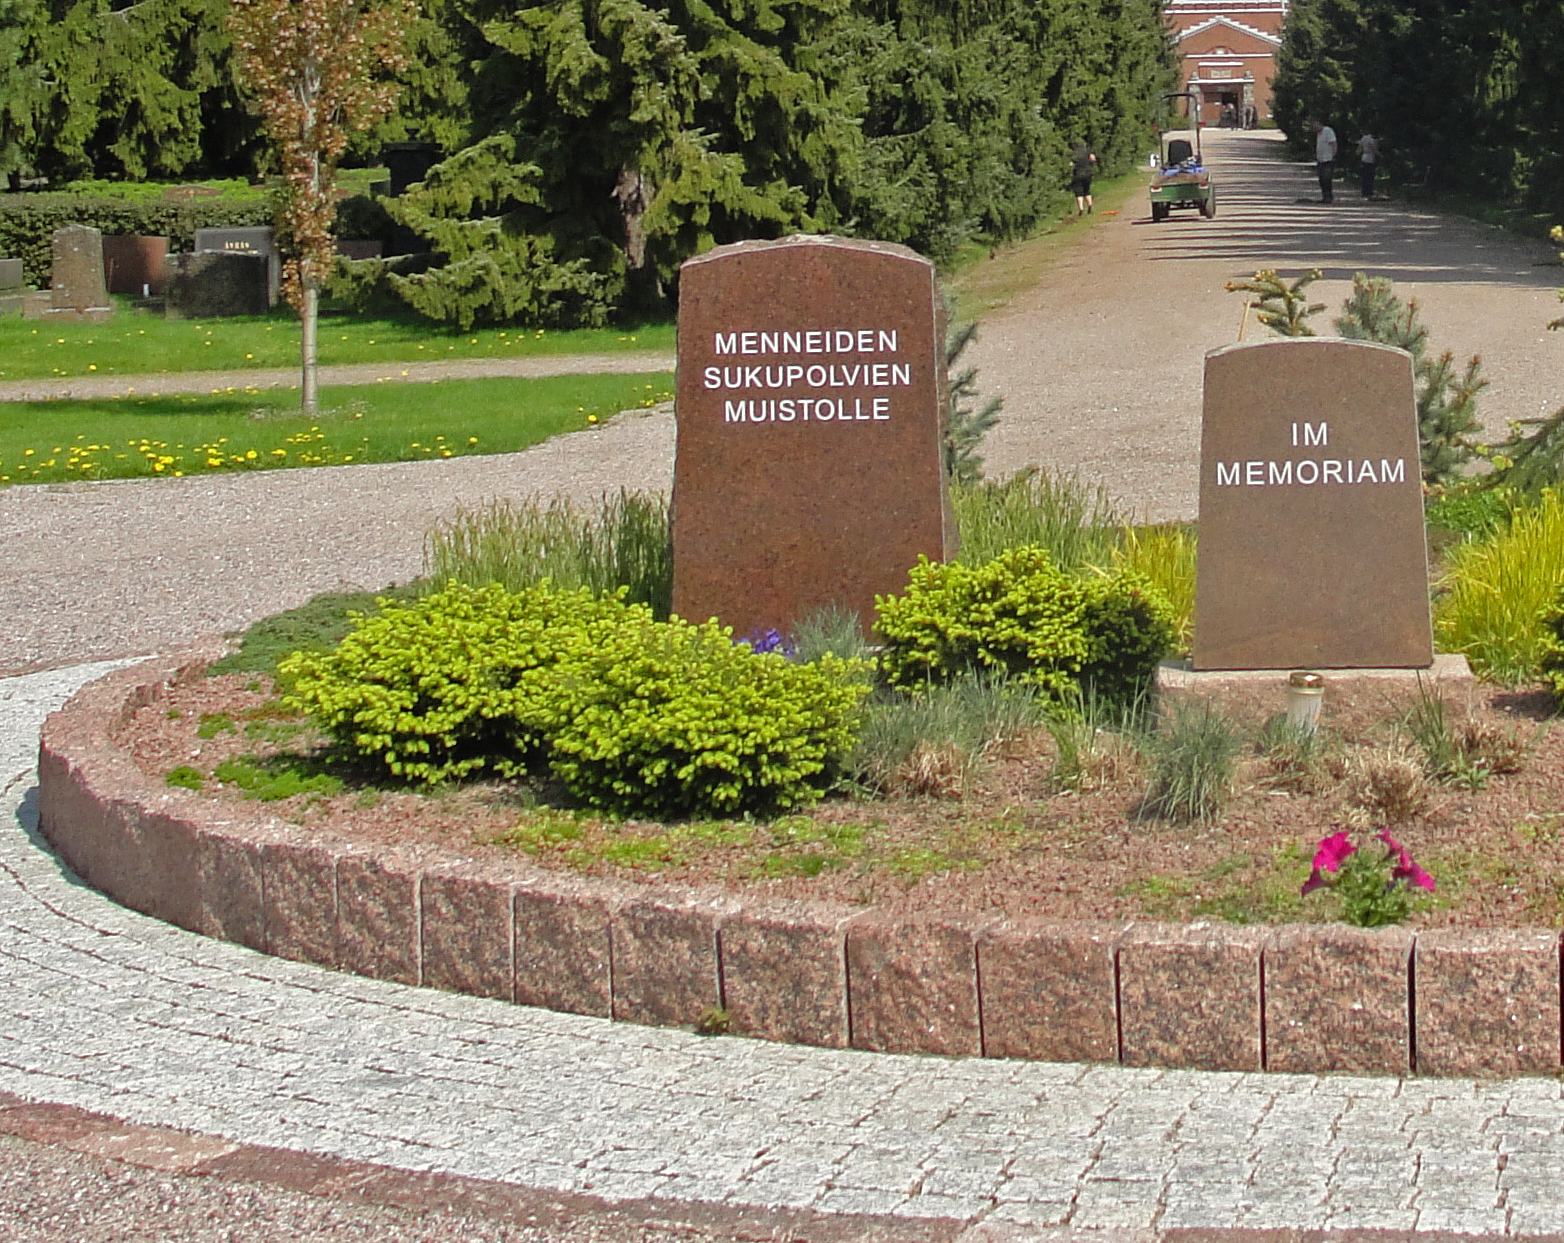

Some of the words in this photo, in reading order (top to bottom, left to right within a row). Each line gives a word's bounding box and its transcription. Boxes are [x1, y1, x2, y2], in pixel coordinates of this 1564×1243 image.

[715, 329, 897, 355] MENNEIDEN
[704, 363, 910, 389] SUKUPOLVIEN
[725, 398, 890, 423] MUISTOLLE
[1292, 422, 1328, 446] IM
[1217, 459, 1405, 486] MEMORIAM
